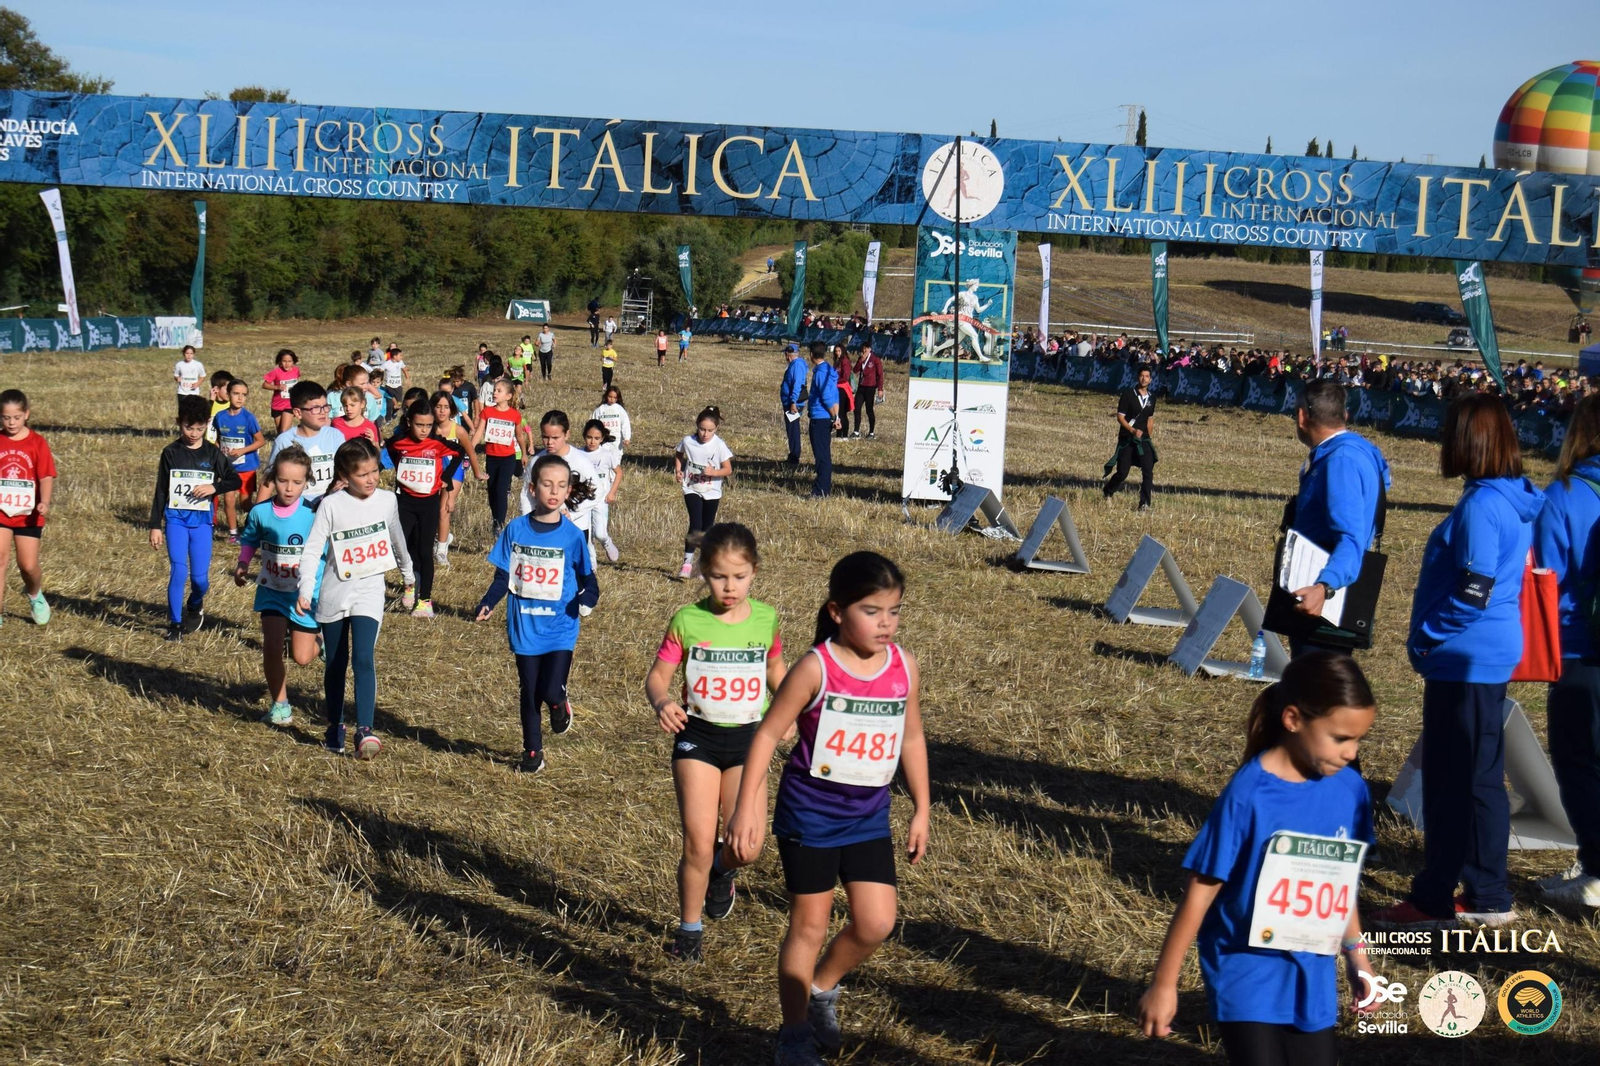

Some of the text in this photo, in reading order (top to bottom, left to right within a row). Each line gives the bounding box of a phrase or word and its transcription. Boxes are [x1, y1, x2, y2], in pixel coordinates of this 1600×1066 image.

[145, 111, 444, 173] XLIII CROSS
[314, 156, 492, 181] INTERNACIONAL
[504, 118, 821, 202] ITÁLICA
[142, 170, 458, 200] INTERNATIONAL CROSS COUNTRY
[1053, 154, 1353, 218] XLIII CROSS
[1222, 200, 1400, 230] INTERNACIONAL
[1047, 212, 1367, 249] INTERNATIONAL CROSS COUNTRY
[968, 248, 1002, 258] Sevilla
[488, 428, 512, 438] 4534
[401, 470, 433, 483] 4516
[342, 540, 388, 565] 4348
[515, 563, 559, 585] 4392
[711, 651, 749, 661] ITÁLICA
[693, 676, 761, 701] 4399
[852, 702, 892, 714] ITÁLICA
[825, 730, 897, 761] 4481
[1297, 840, 1340, 858] ITÁLICA
[1267, 878, 1348, 921] 4504
